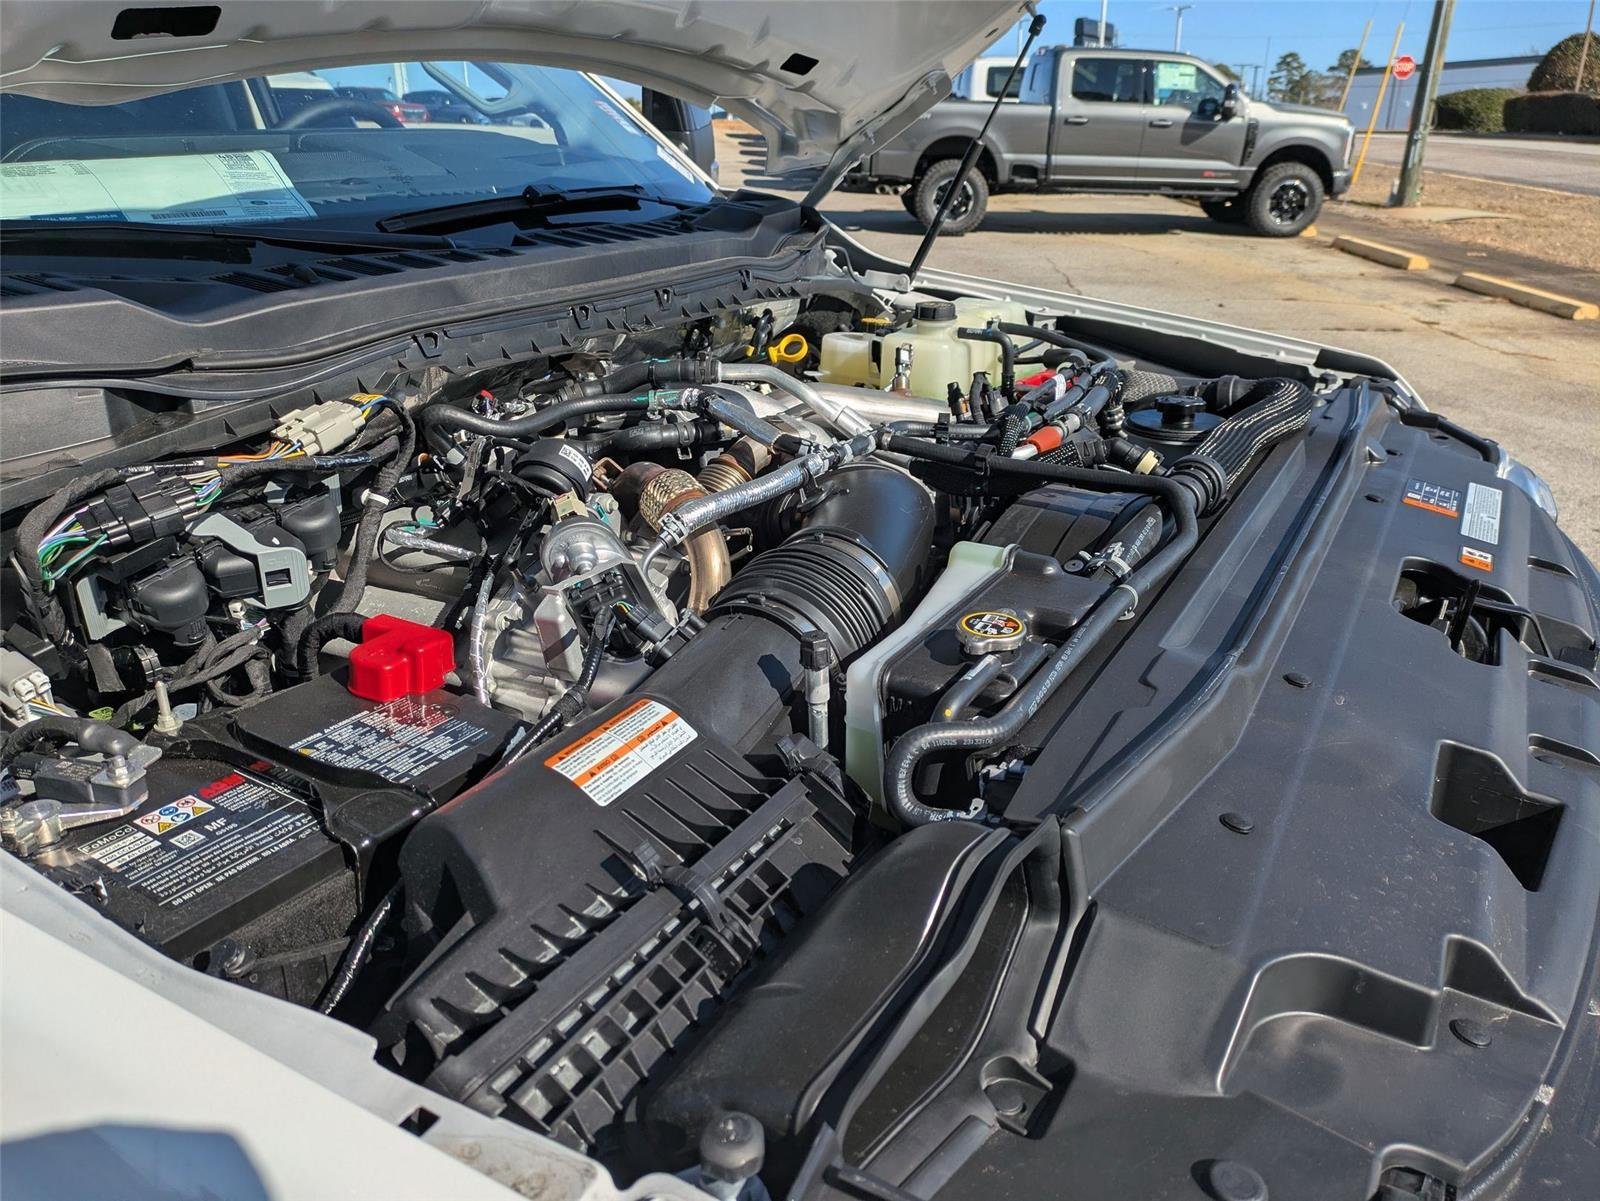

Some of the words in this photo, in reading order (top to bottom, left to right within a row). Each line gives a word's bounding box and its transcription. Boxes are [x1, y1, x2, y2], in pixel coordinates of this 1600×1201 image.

[204, 817, 227, 831] MF
[82, 827, 133, 852] FoMoCo
[180, 890, 196, 900] NOT
[194, 880, 216, 892] OPEN.
[223, 867, 238, 877] PAS
[235, 855, 262, 870] OUVRIR.
